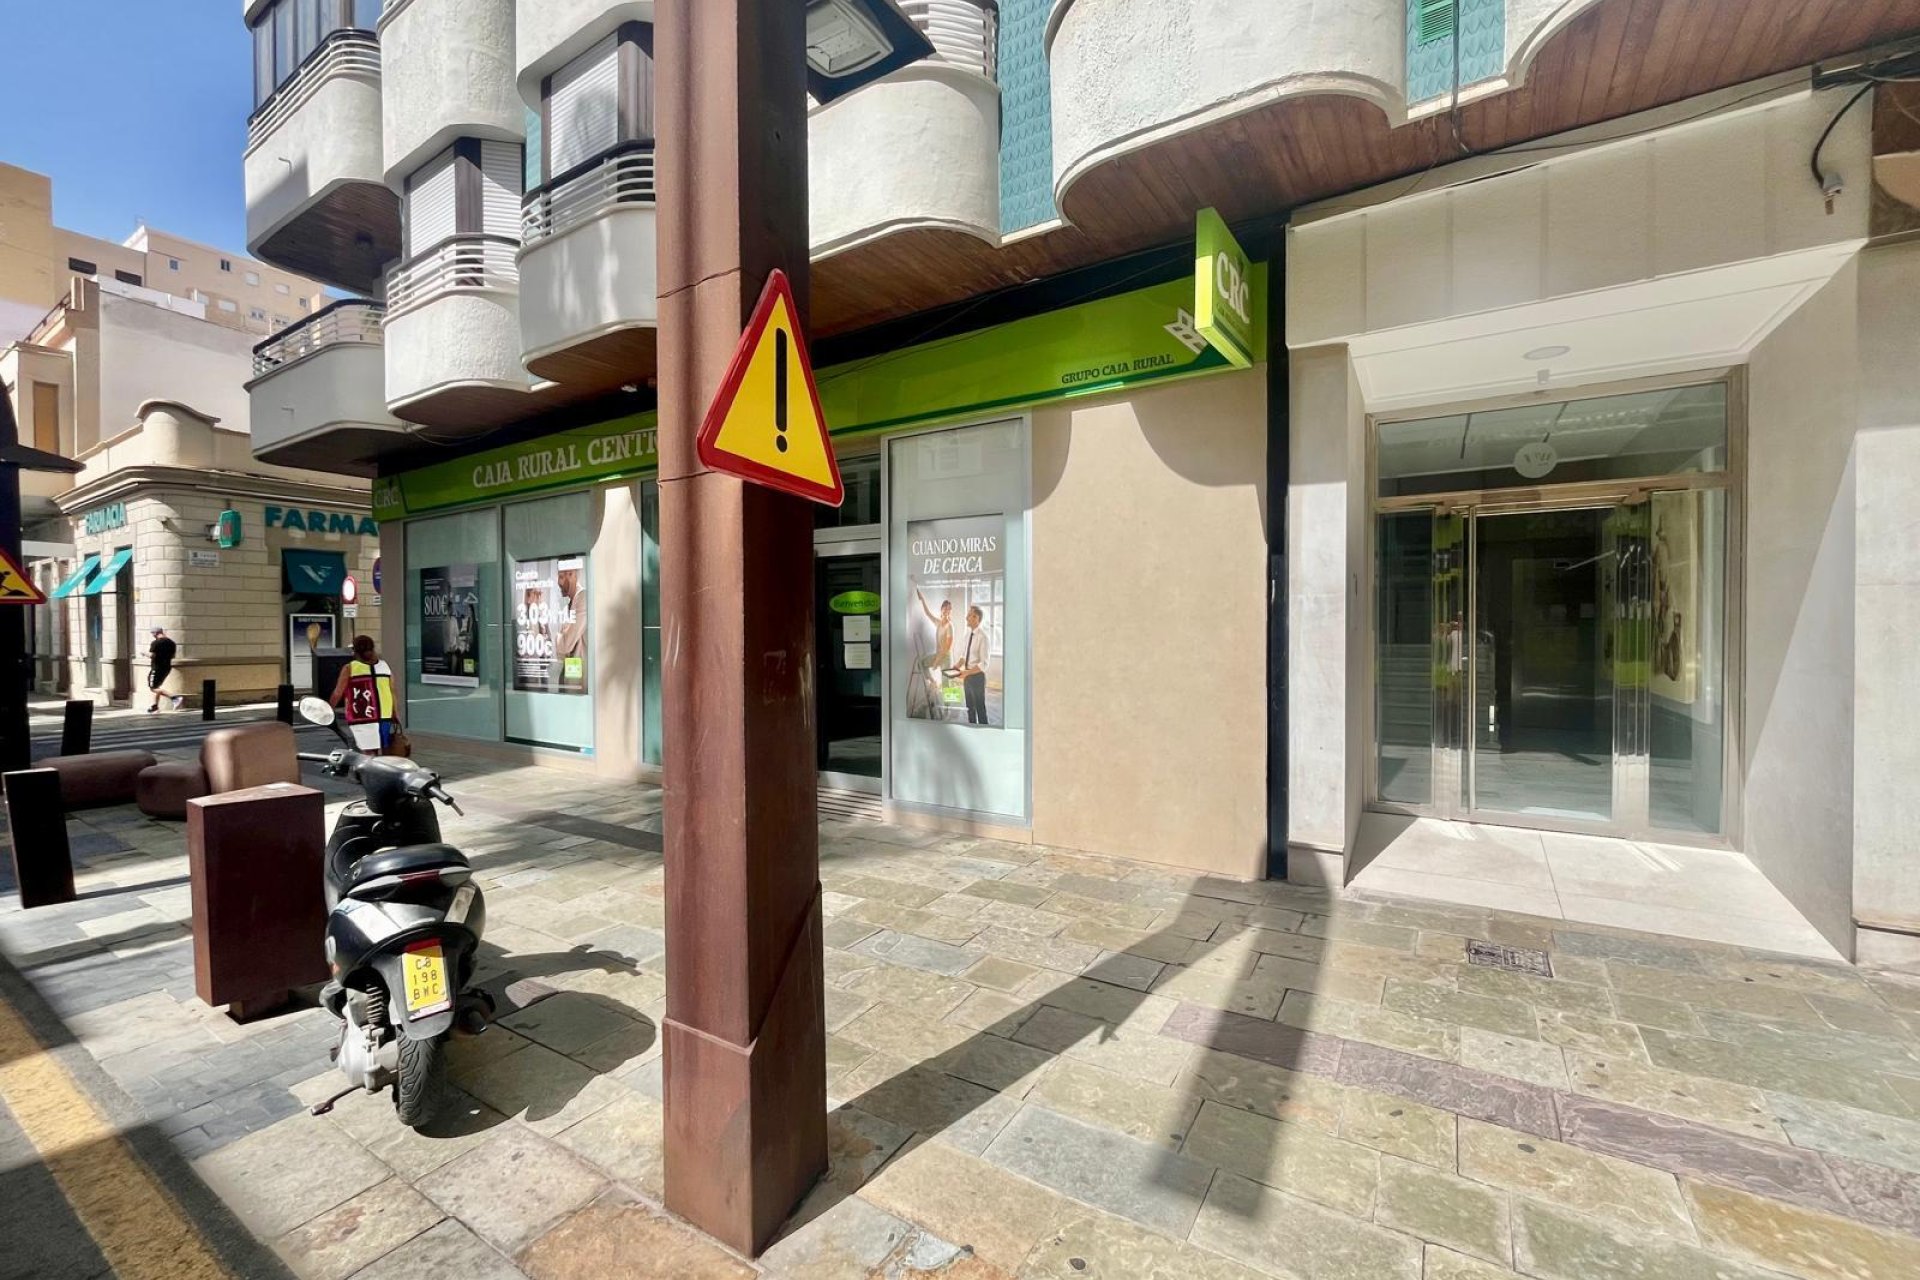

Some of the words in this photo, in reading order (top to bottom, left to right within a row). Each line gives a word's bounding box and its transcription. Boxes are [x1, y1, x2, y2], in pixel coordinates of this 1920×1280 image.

[1216, 251, 1250, 324] CRC
[1061, 368, 1100, 384] GRUPO
[1102, 362, 1130, 376] CAJA
[1133, 353, 1174, 370] RURAL
[473, 464, 513, 489] CAJA
[518, 445, 581, 480] RURAL
[912, 539, 958, 556] CUANDO
[960, 536, 996, 553] MIRAS
[924, 558, 941, 575] DE
[942, 556, 983, 574] CERCA
[413, 969, 438, 985] 198
